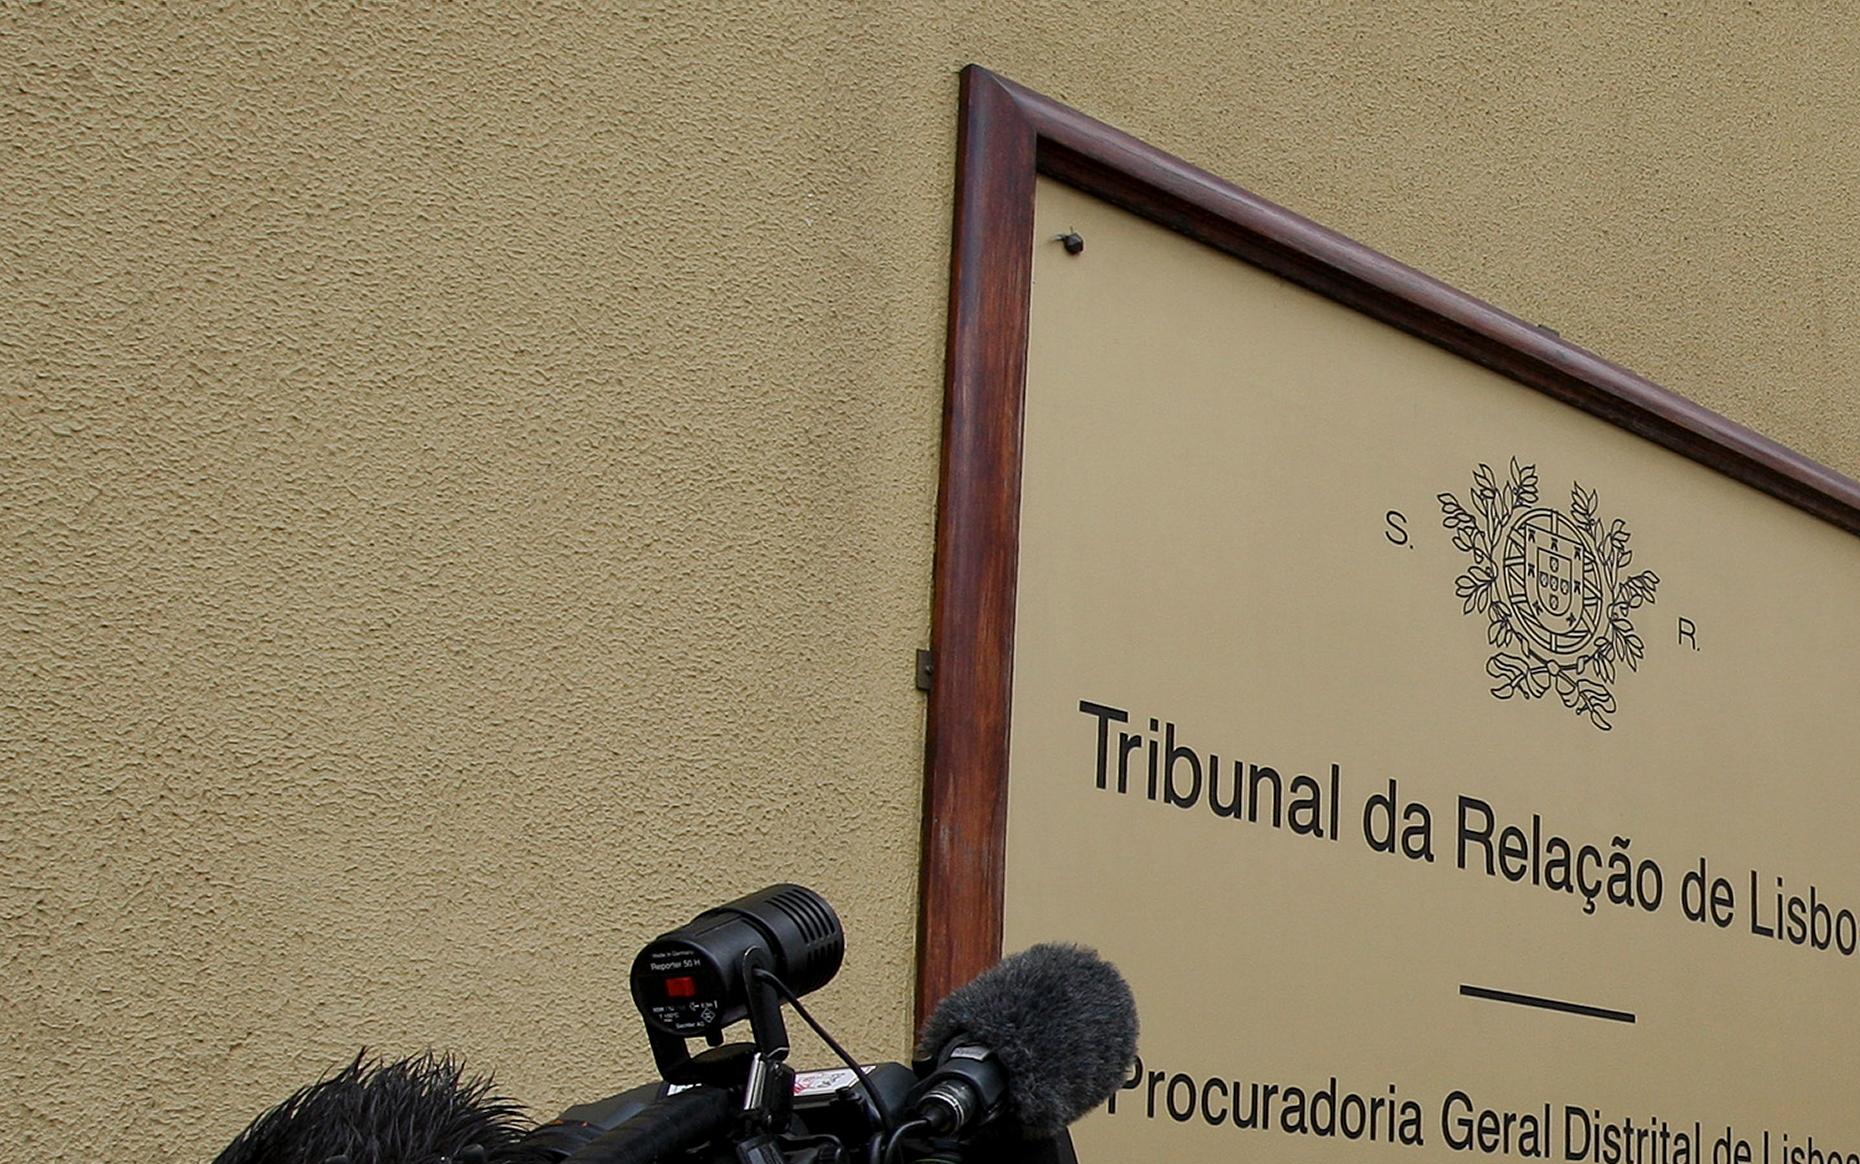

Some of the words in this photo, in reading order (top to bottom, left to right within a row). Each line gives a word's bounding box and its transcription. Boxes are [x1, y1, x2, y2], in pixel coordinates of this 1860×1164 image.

[1079, 700, 1340, 841] Tribunal
[1363, 778, 1435, 863] da
[1457, 794, 1664, 915] Relação
[1681, 857, 1735, 929] de
[650, 961, 682, 971] Reporter
[1441, 1090, 1552, 1159] Geral
